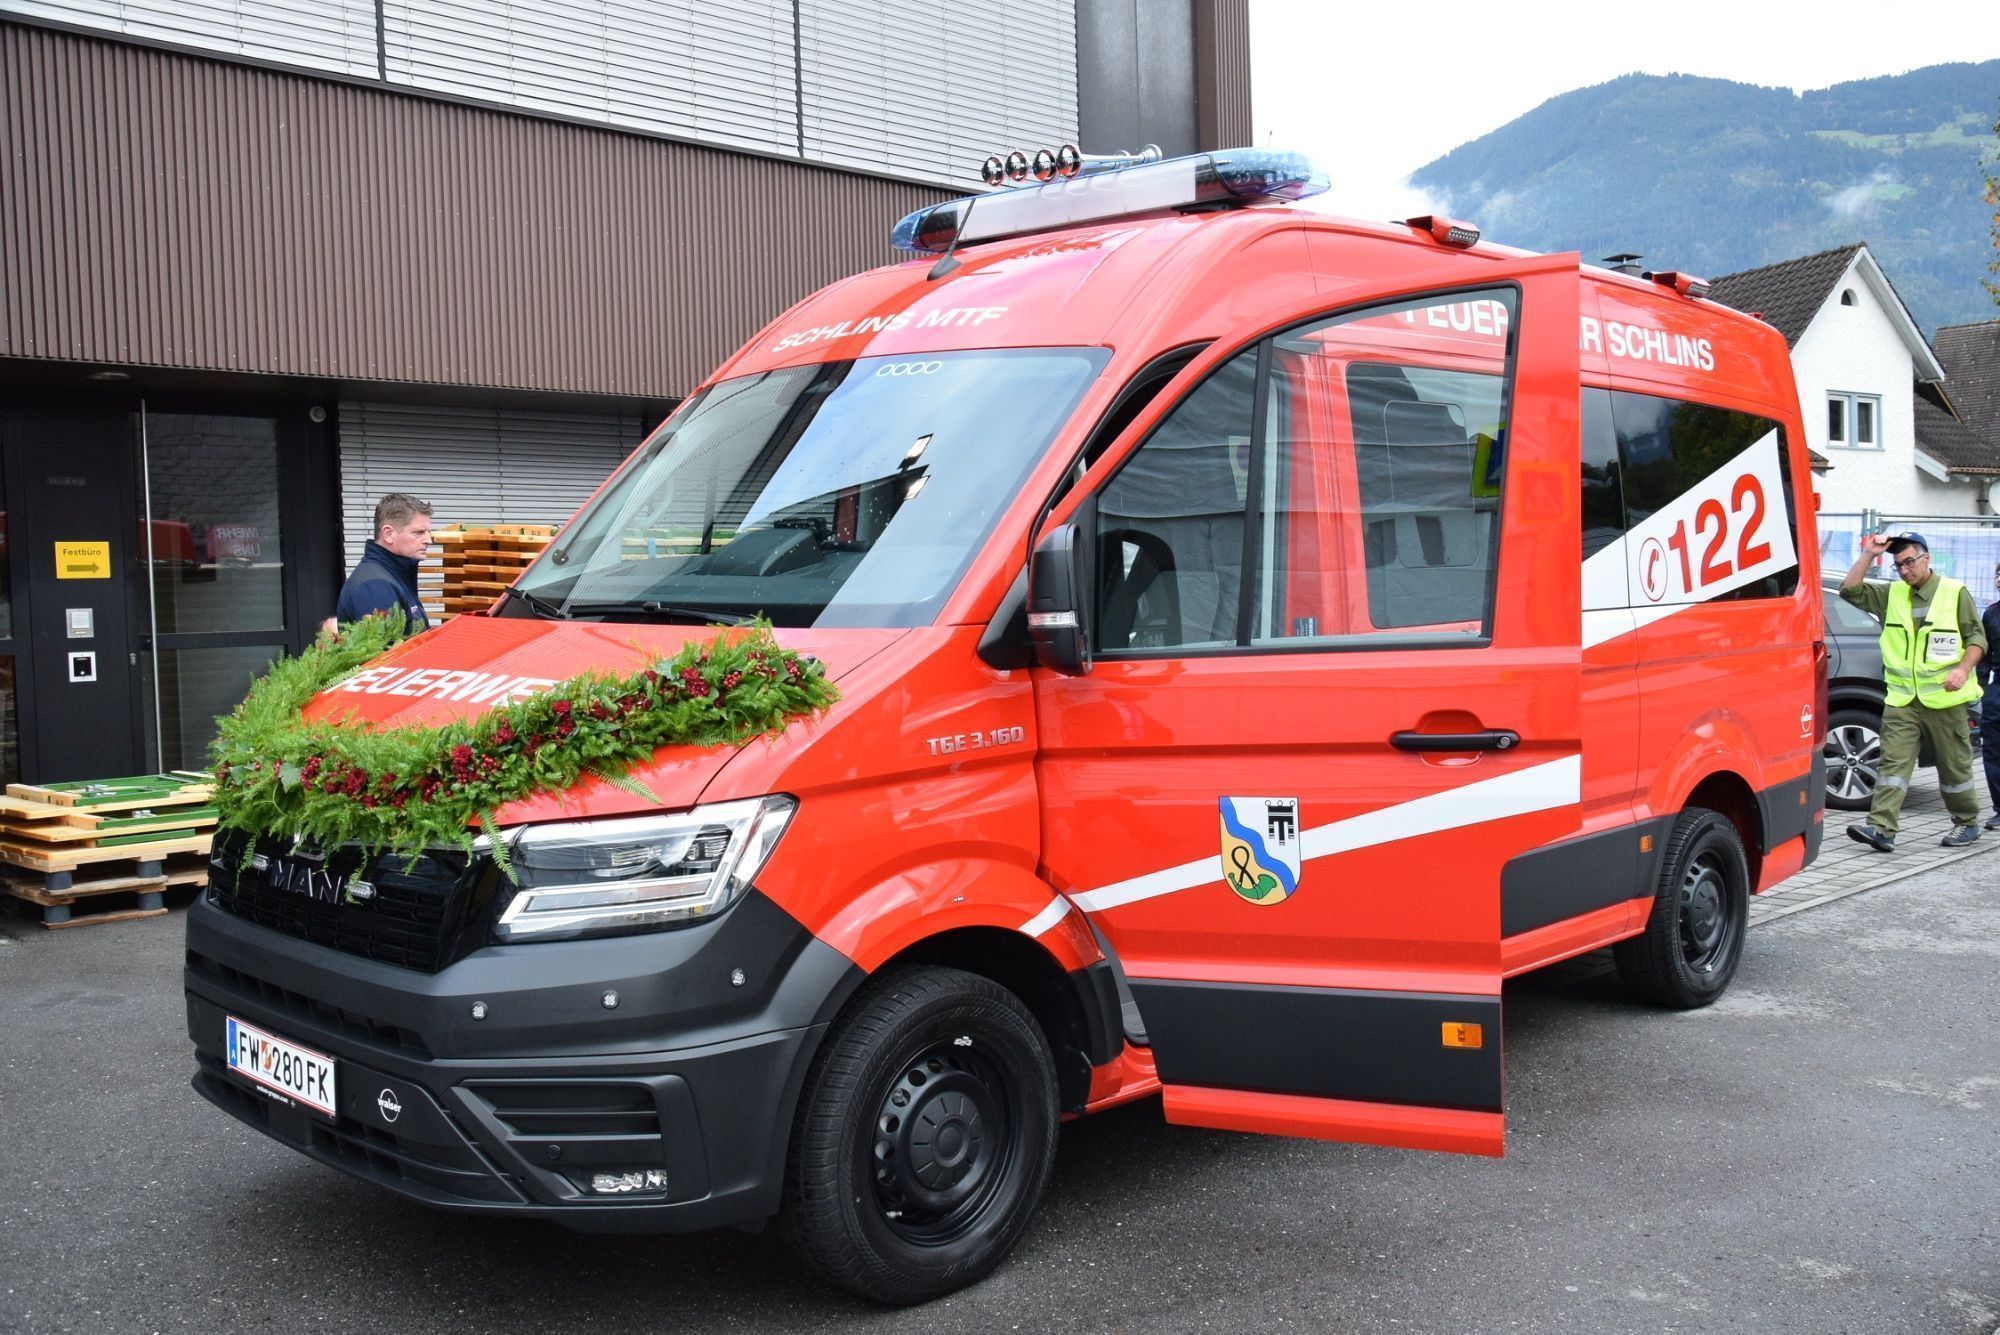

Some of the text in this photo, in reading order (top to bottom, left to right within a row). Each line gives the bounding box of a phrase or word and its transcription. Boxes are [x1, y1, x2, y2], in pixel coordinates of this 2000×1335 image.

[772, 306, 1008, 352] SCHLINS MTF
[1607, 321, 1716, 371] SCHLINS
[63, 548, 102, 556] Festbüro
[1667, 473, 1771, 594] 122
[926, 726, 1024, 755] TGE 3.160
[270, 859, 343, 905] MAN
[239, 1030, 260, 1073] FW
